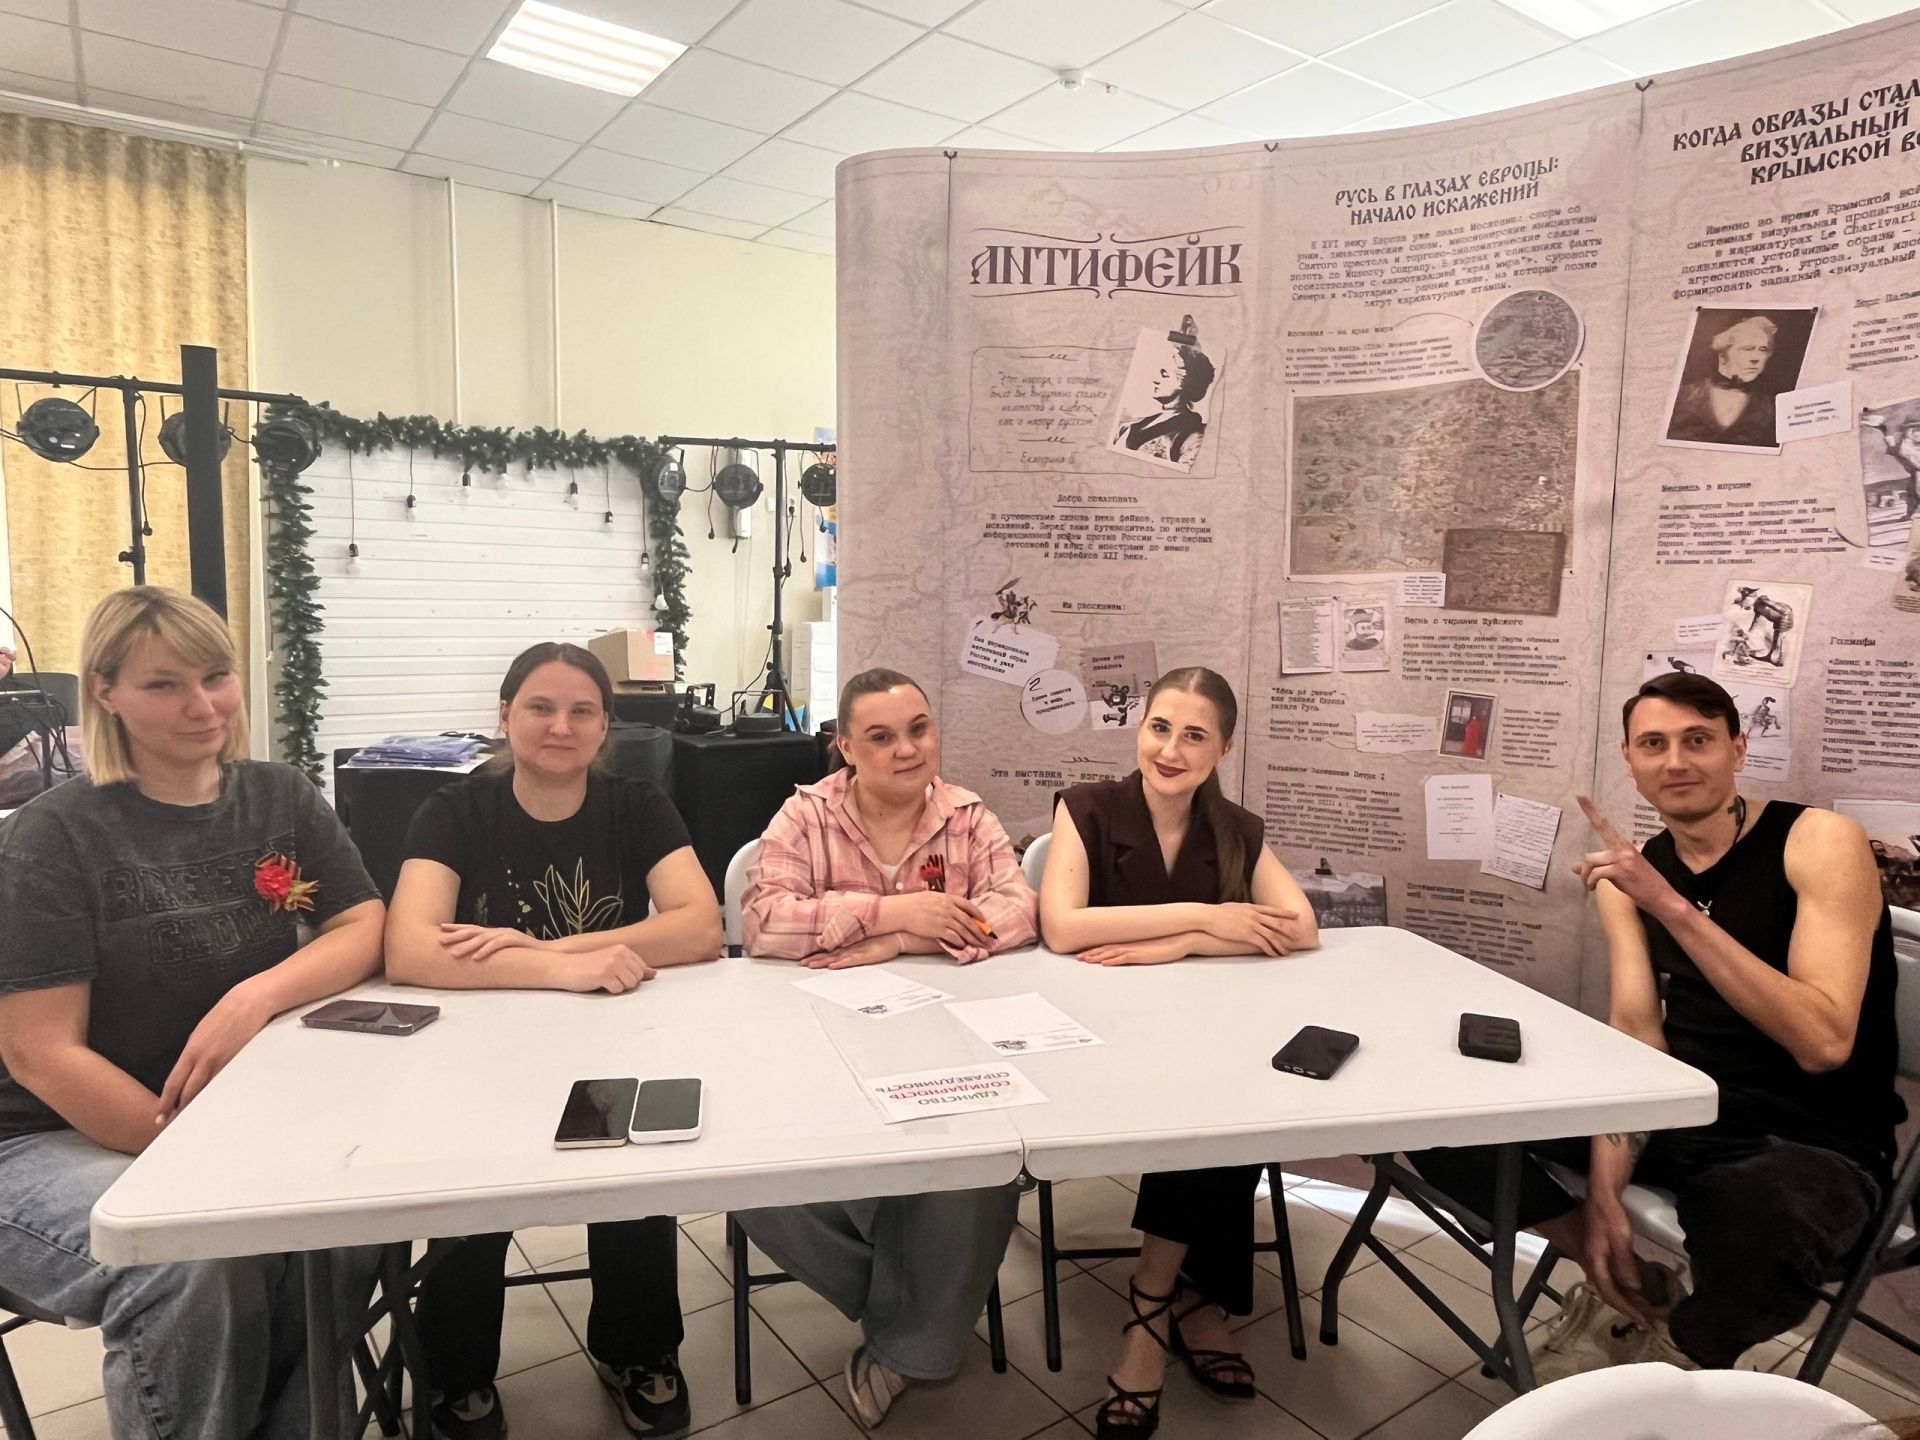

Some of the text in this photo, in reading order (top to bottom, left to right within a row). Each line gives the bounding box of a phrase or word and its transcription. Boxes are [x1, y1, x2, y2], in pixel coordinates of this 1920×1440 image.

[1673, 123, 1742, 150] КОГДА
[1751, 97, 1848, 136] ОБРАЗЫ
[1741, 101, 1909, 162] ВИЗУАЛЬНЫЙ
[1751, 131, 1891, 185] КРЫМСКОЙ
[1336, 189, 1378, 208] РУСЬ
[1385, 185, 1395, 201] В
[1402, 174, 1472, 199] ГЛАЗАХ
[1479, 157, 1559, 187] ЕВРОПЫ:
[1351, 176, 1539, 225] НАЧАЛО ИСКАЖЕНИЙ
[1706, 222, 1749, 235] Именно
[1758, 218, 1773, 227] во
[1781, 209, 1820, 224] время
[1827, 192, 1890, 215] Крымской
[1687, 233, 1754, 250] системная
[1761, 218, 1837, 239] визуальная
[1730, 235, 1812, 255] карикатурах
[1761, 243, 1839, 265] устойчивые
[1847, 231, 1895, 247] образы
[970, 235, 1242, 289] АНТИФЕЙК
[1861, 246, 1885, 257] Эти
[1673, 282, 1752, 300] формировать
[1761, 269, 1821, 287] западный
[1057, 495, 1083, 503] Добро
[1029, 678, 1043, 692] 2
[1036, 780, 1065, 789] экран
[875, 1071, 1010, 1093] СПРАВЕДЛИВОСТЬ
[889, 1080, 1011, 1100] СОЛИДАРНОСТЬ
[918, 1090, 999, 1106] ЕДИНСТВО
